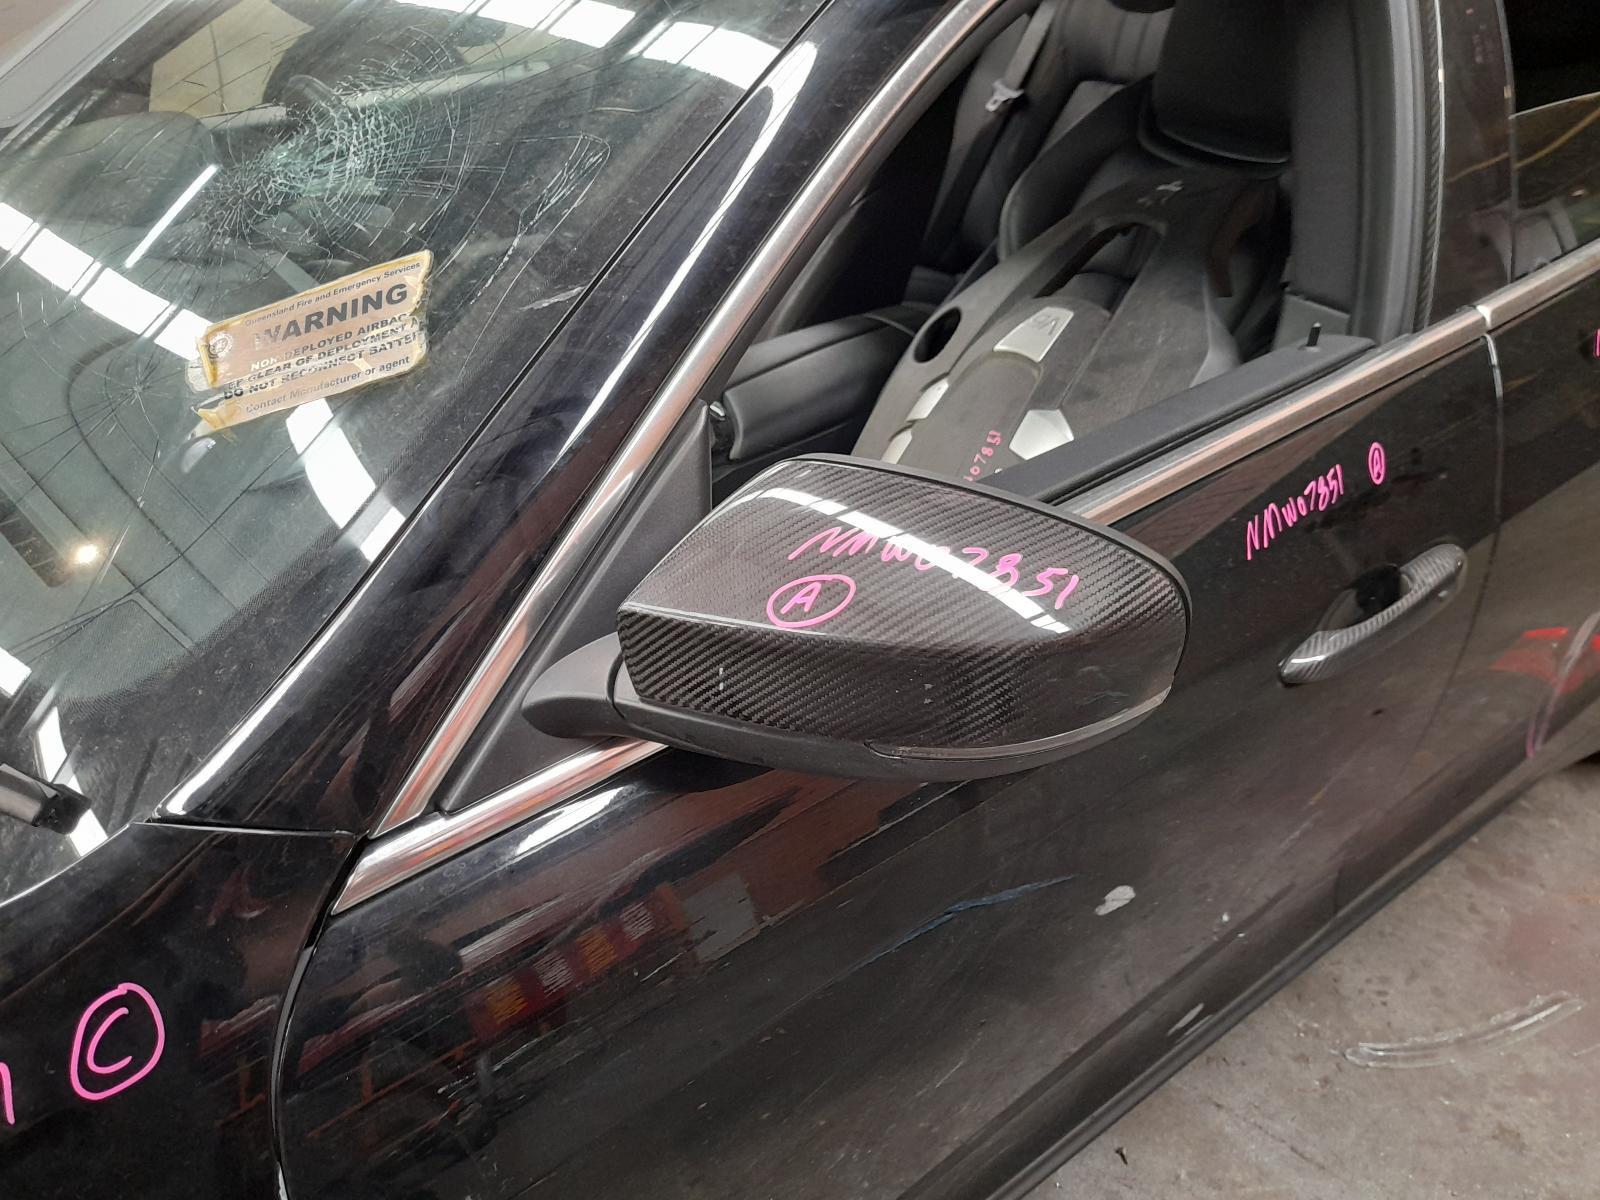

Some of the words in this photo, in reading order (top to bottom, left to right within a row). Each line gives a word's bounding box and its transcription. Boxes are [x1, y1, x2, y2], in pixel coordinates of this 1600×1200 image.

[245, 304, 295, 327] Queensland
[296, 298, 313, 311] Fire
[315, 292, 331, 303] and
[333, 275, 381, 296] Emergency
[384, 262, 421, 279] Services
[223, 388, 243, 400] DO
[249, 379, 276, 393] NOT
[246, 394, 286, 413] Contact
[289, 370, 361, 400] Manufacturer
[364, 367, 376, 376] or
[379, 356, 410, 373] agent
